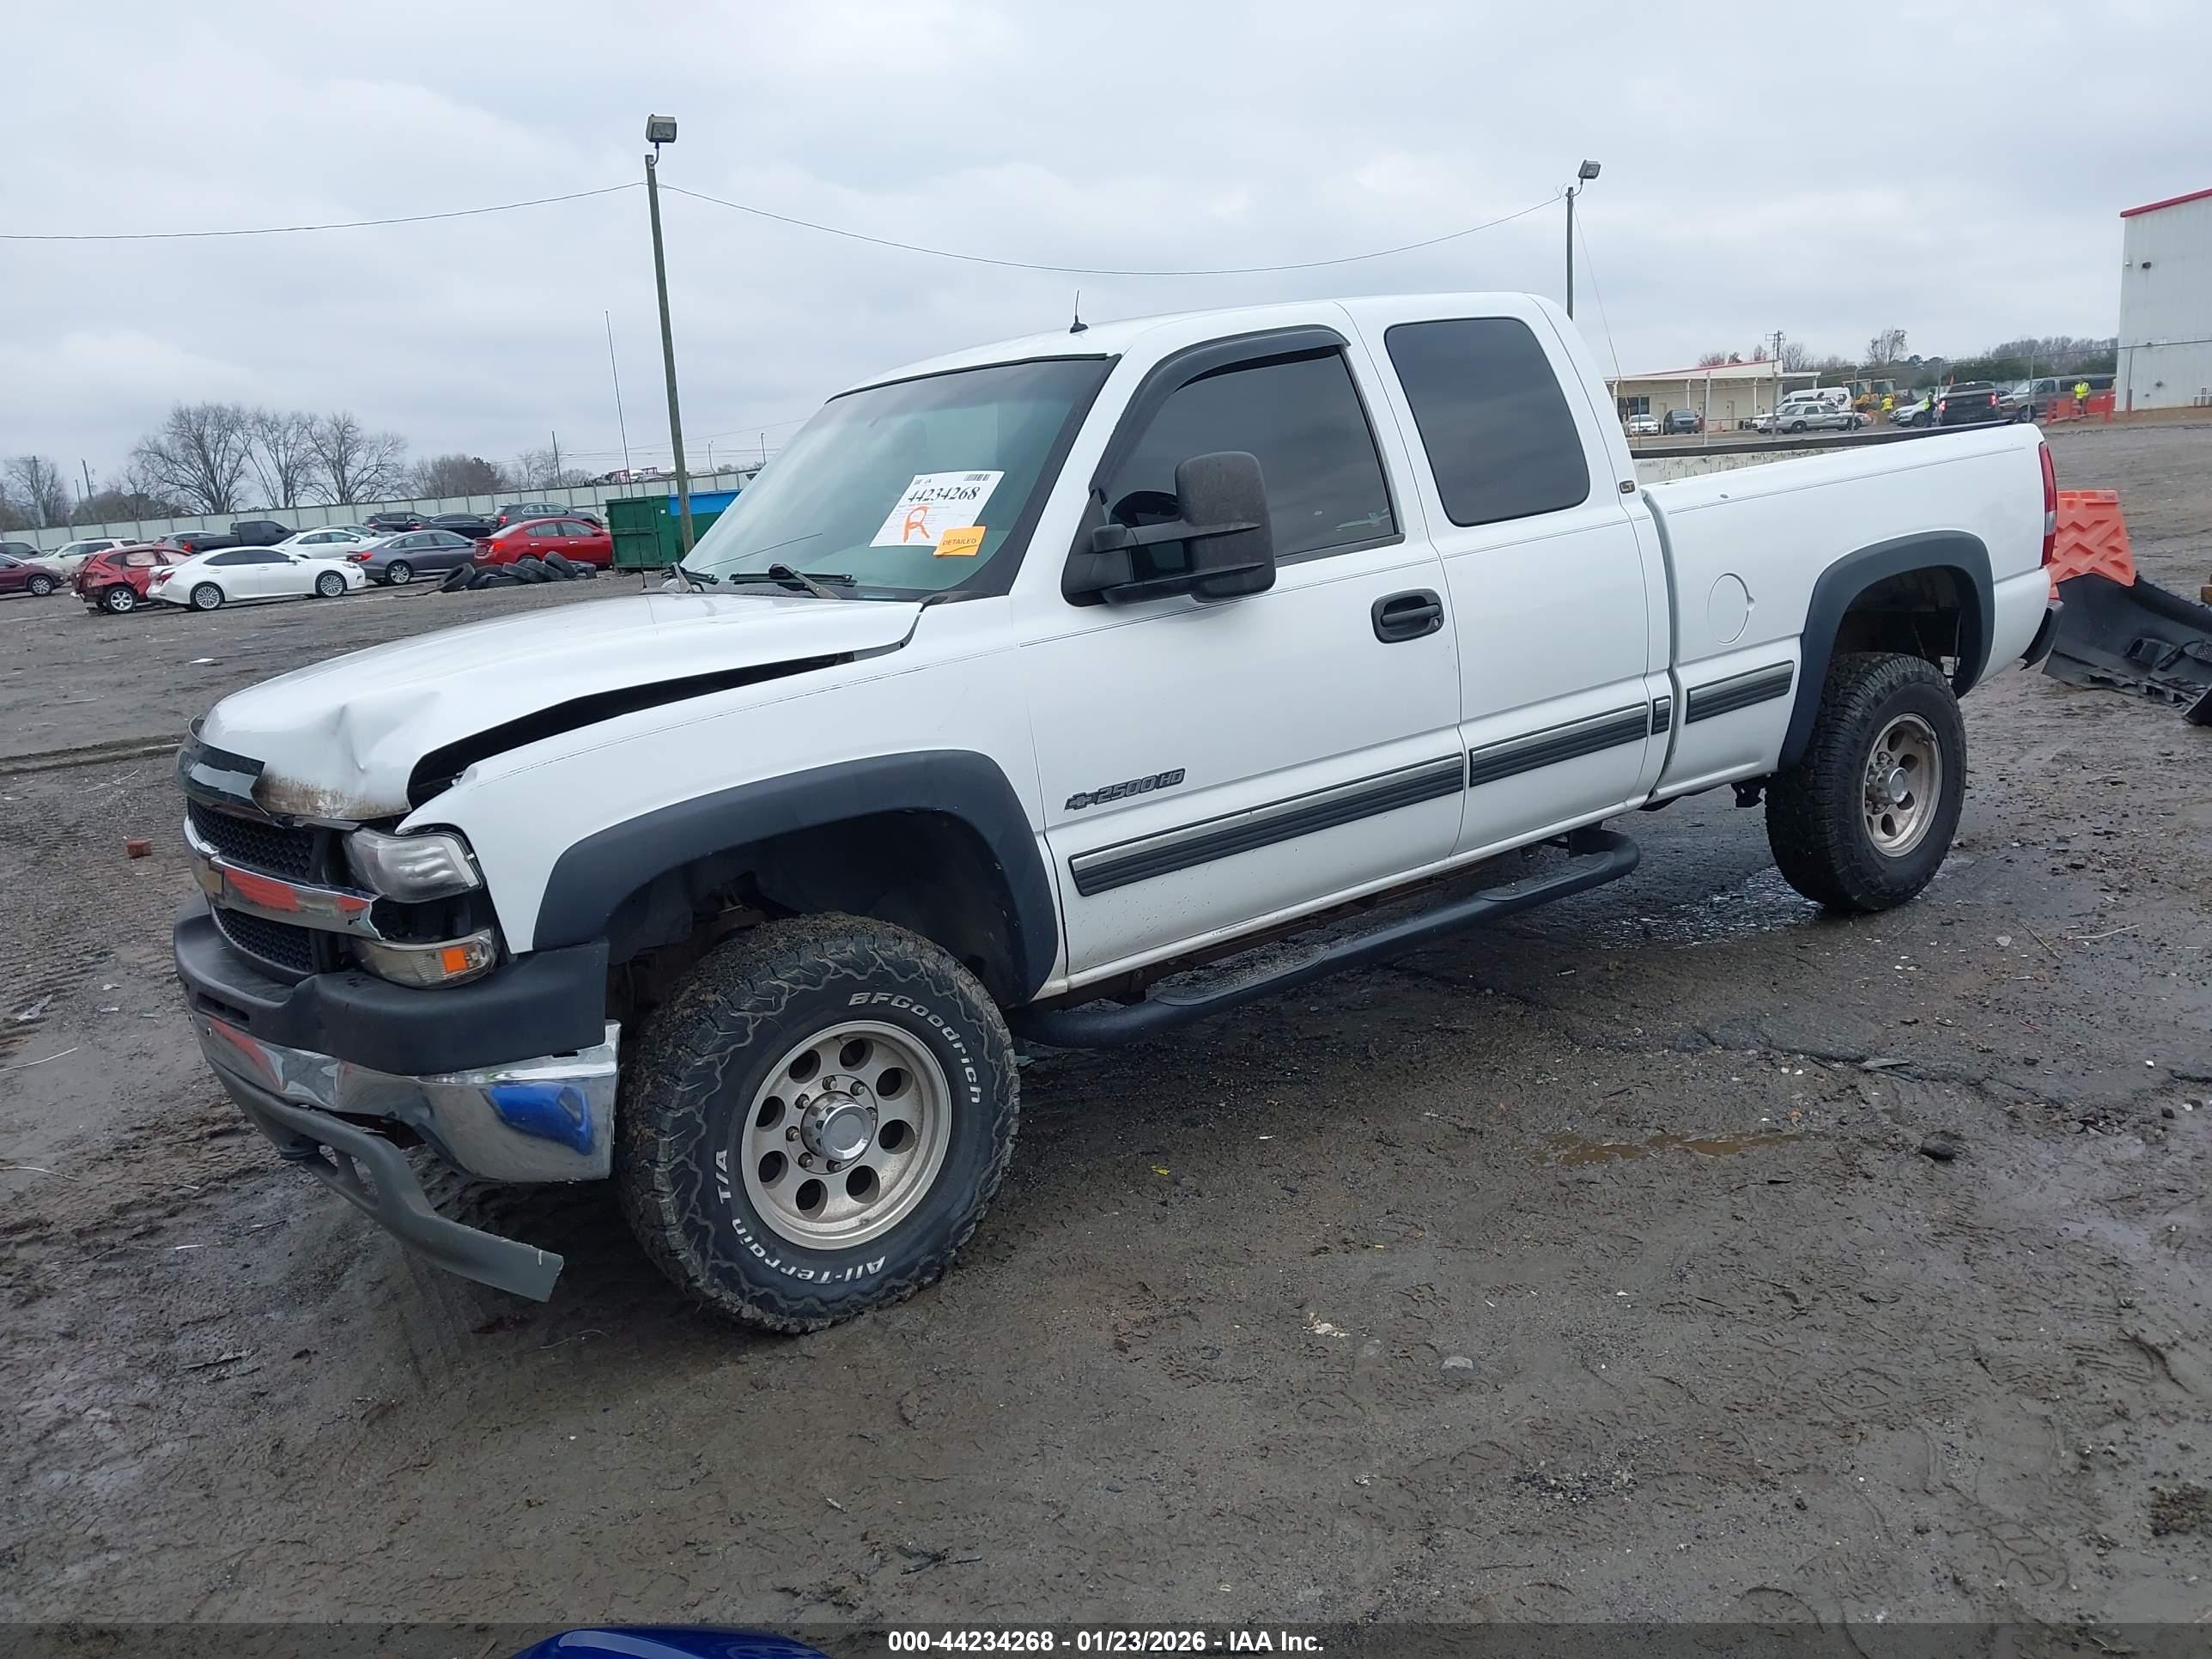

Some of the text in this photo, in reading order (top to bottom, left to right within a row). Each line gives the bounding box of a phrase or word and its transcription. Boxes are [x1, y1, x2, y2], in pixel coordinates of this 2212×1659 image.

[908, 486, 981, 502] 44234268
[902, 506, 930, 543] R
[1097, 770, 1184, 803] 2500 HD
[848, 992, 982, 1103] BFGoodrich
[715, 1149, 886, 1285] All-Terrain T/A
